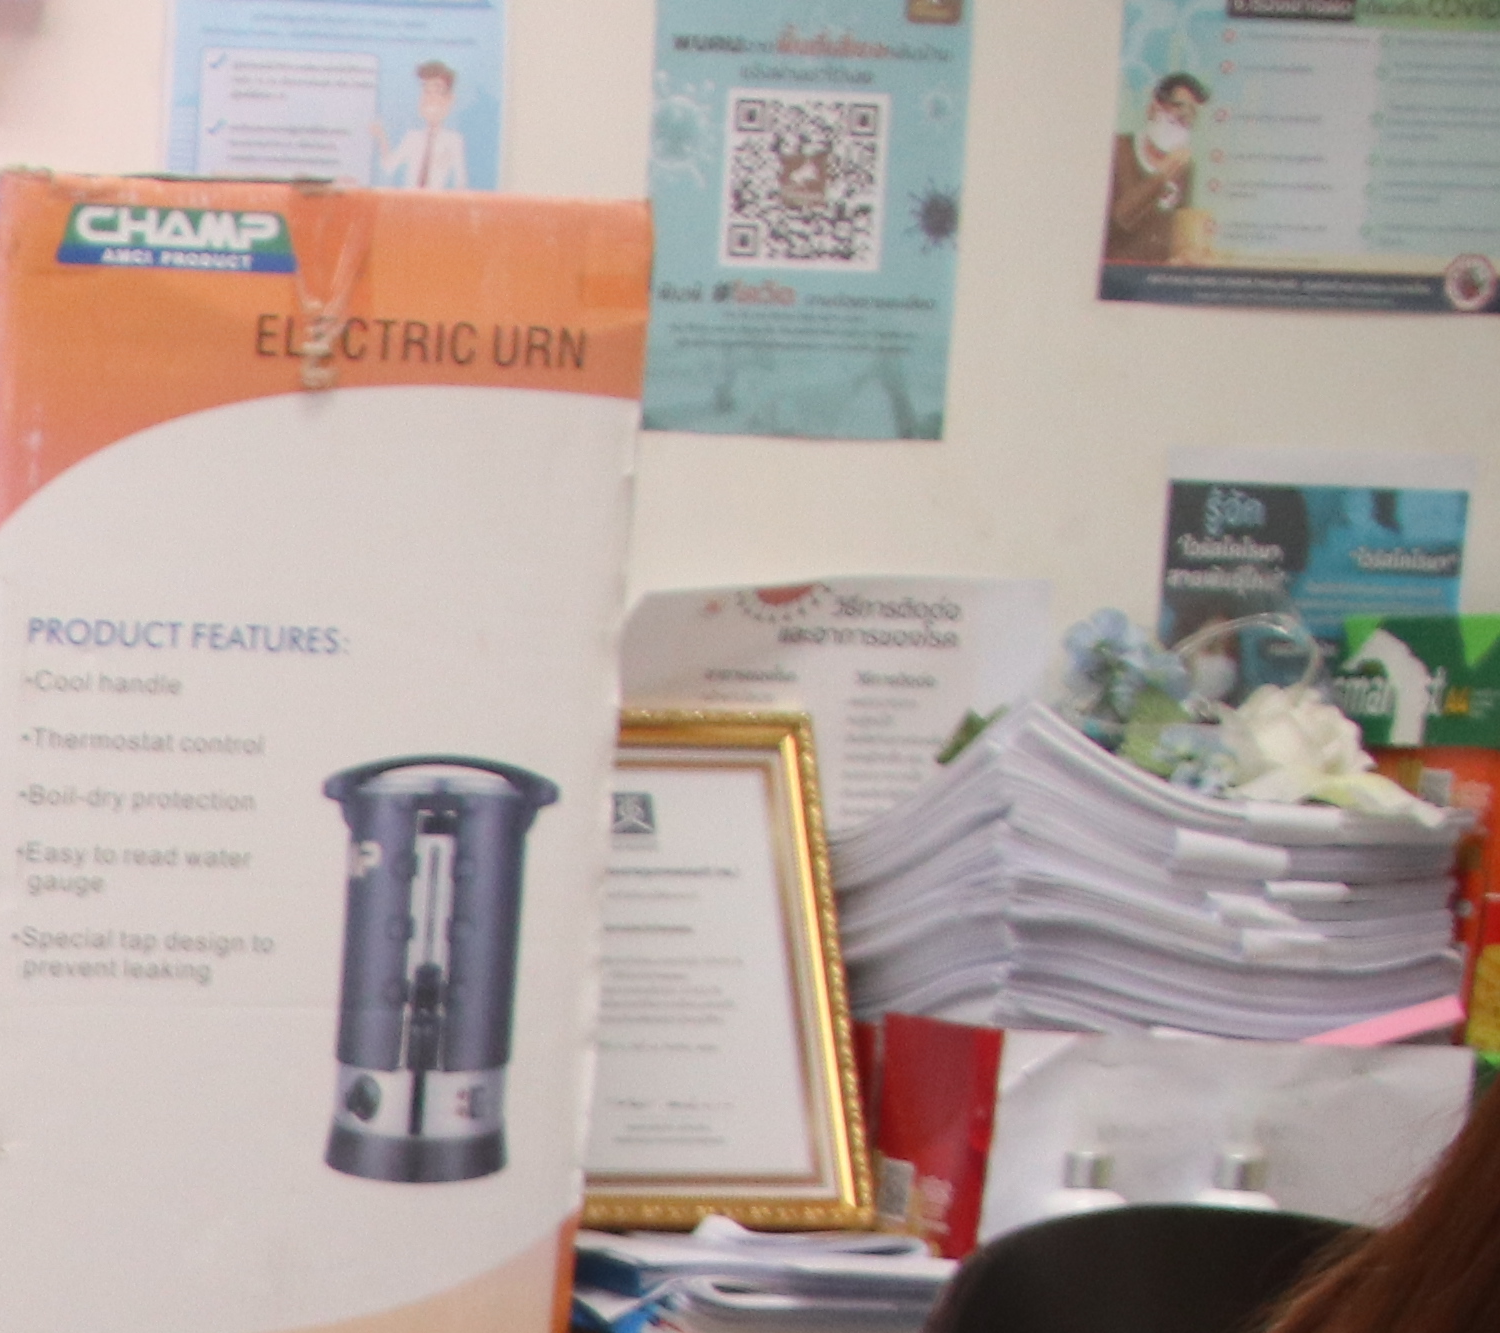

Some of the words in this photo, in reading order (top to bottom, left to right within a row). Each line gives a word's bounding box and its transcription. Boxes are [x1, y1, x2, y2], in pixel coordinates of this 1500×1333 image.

[74, 205, 281, 249] CHAMP
[101, 248, 154, 267] AMCI
[160, 249, 254, 271] PRODUCT
[493, 324, 587, 370] URN
[27, 616, 183, 648] PRODUCT
[191, 621, 351, 654] FEATURES:
[34, 669, 92, 693] Cool
[99, 672, 183, 696] handle
[33, 726, 174, 752] Thermostat
[179, 733, 266, 756] control
[27, 783, 123, 813] Boil-dry
[130, 788, 257, 814] protection
[25, 840, 86, 868] Easy
[93, 845, 117, 866] to
[122, 846, 179, 867] read
[183, 848, 254, 869] water
[27, 873, 105, 897] gauge
[21, 925, 116, 953] Special
[119, 929, 157, 955] tap
[163, 930, 246, 959] design
[250, 933, 275, 954] to
[22, 957, 118, 982] prevent
[123, 960, 213, 987] leaking
